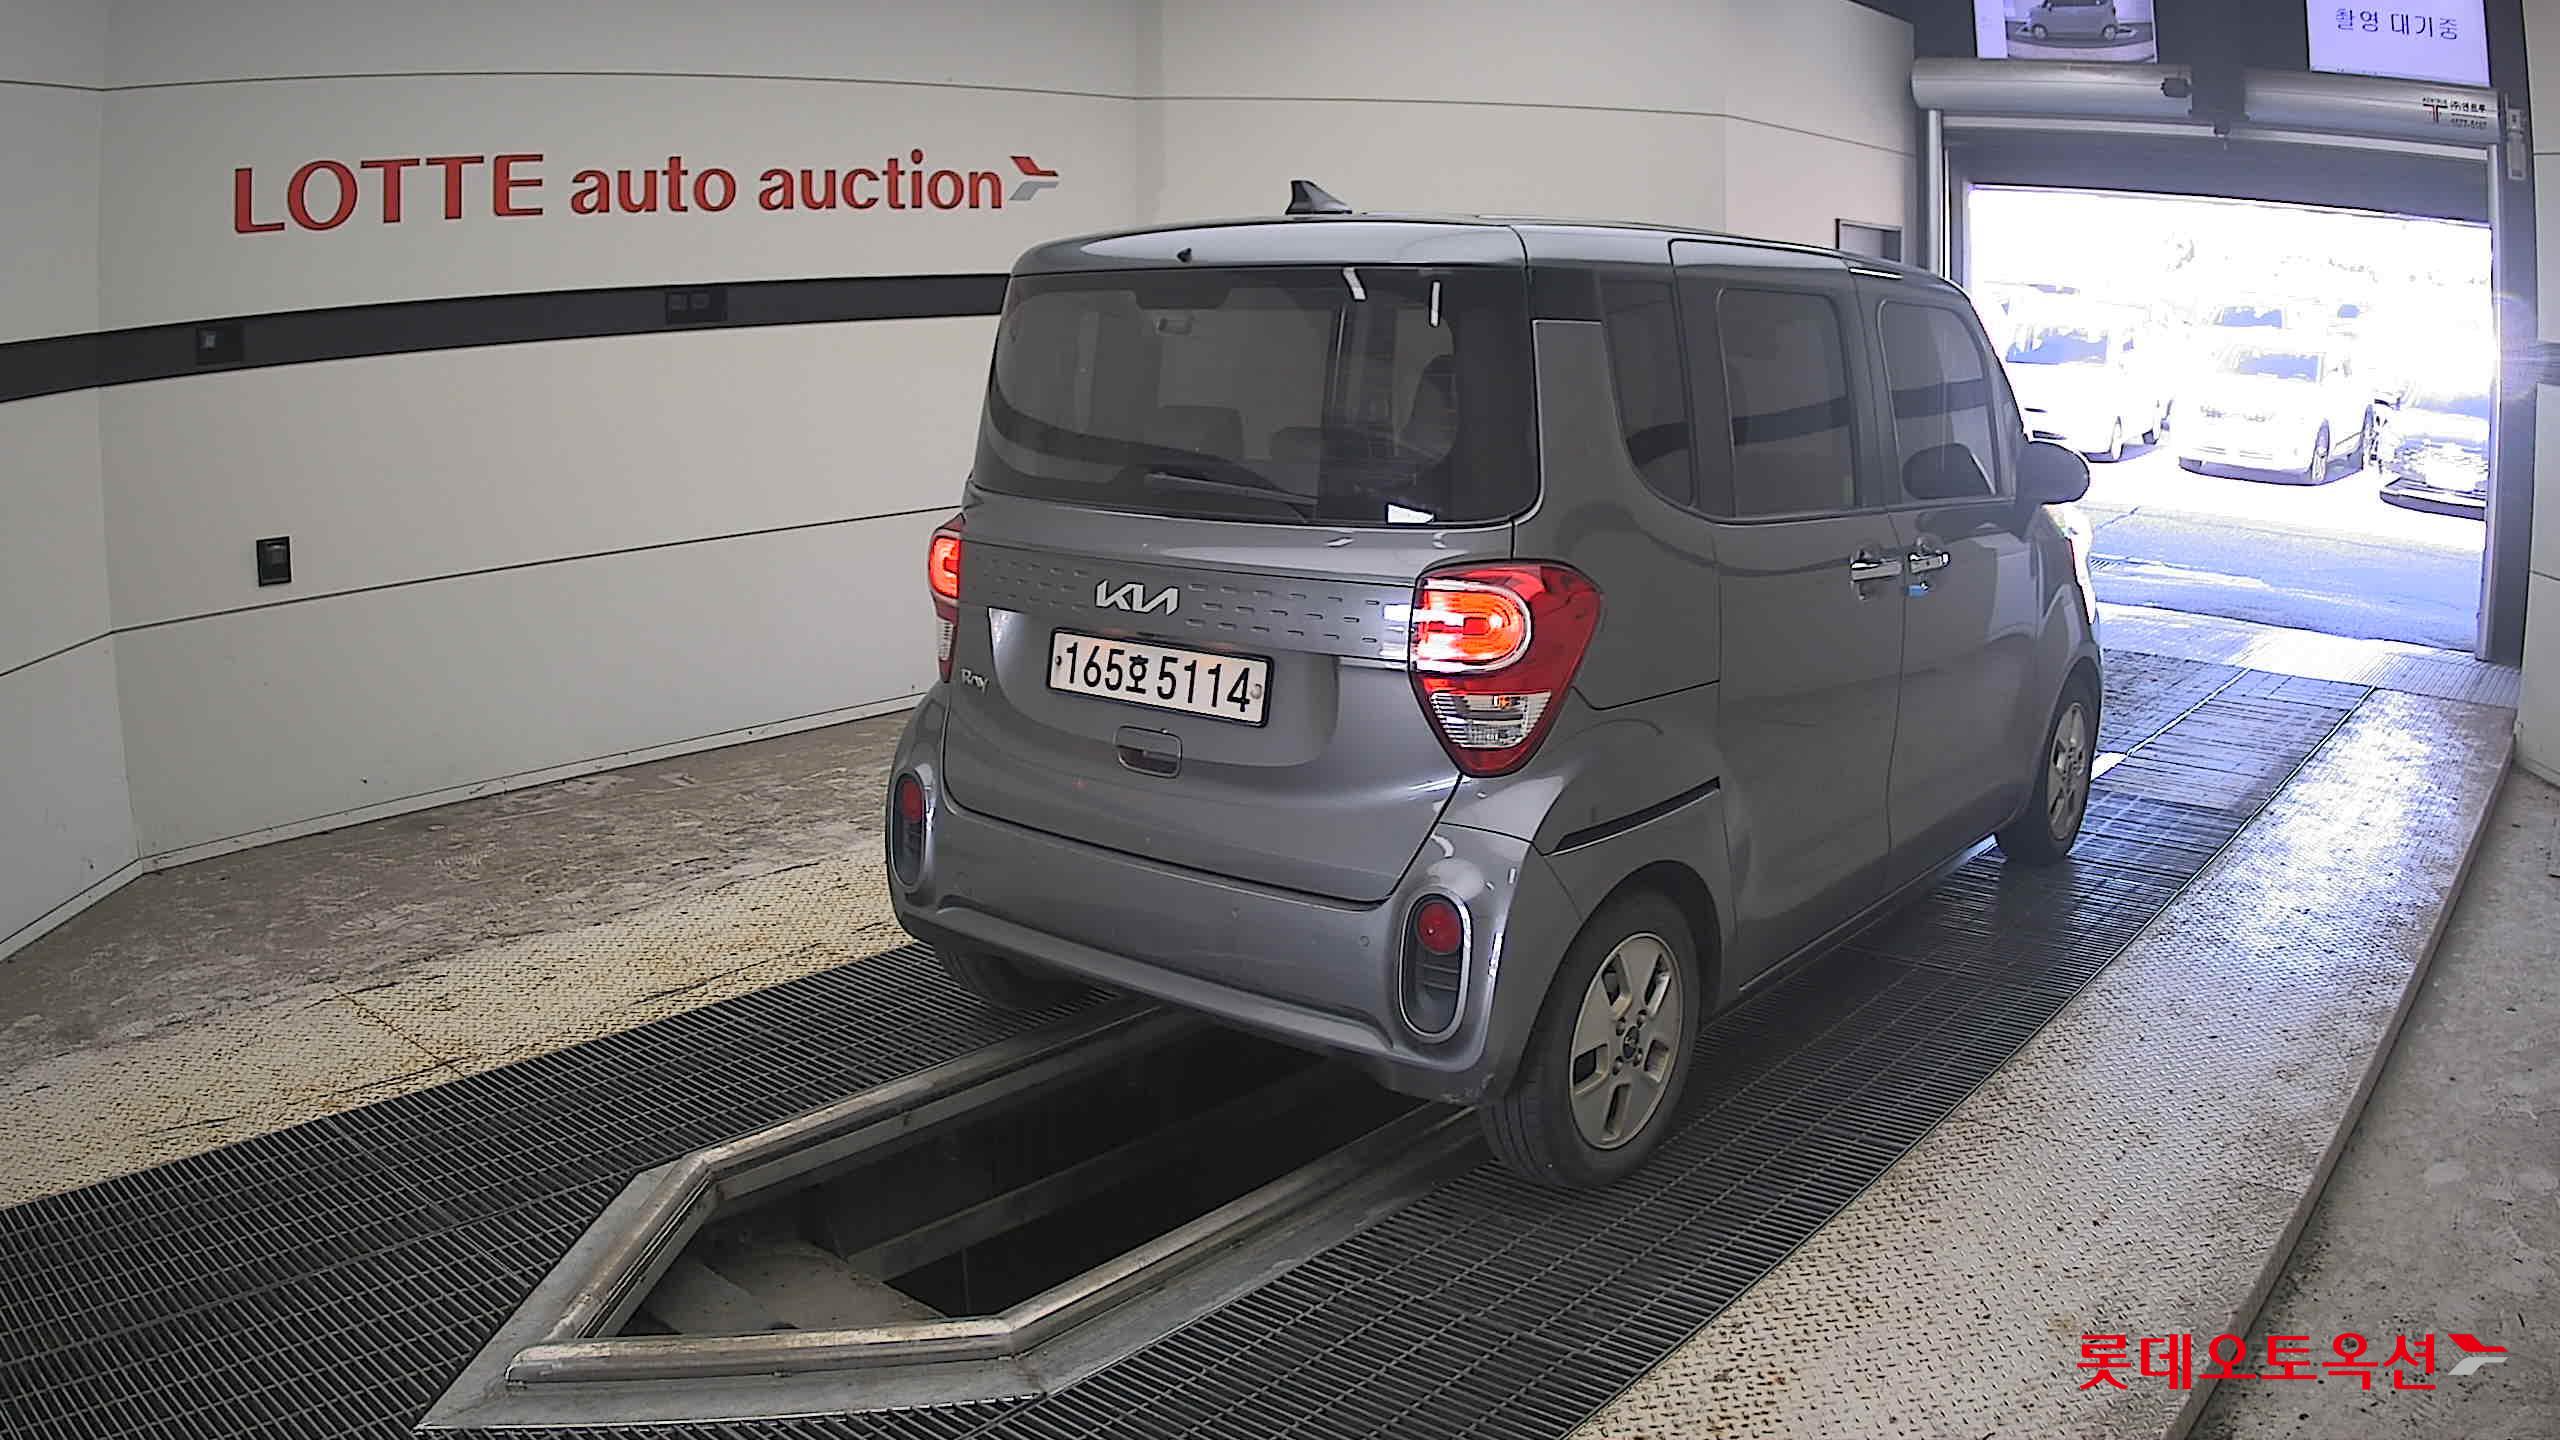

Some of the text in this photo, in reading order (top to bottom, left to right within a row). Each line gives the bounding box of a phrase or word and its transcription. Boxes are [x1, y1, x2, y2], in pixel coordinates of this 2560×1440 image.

[2336, 8, 2458, 40] 촬영 대기중
[233, 147, 1003, 234] LOTTE auto auction
